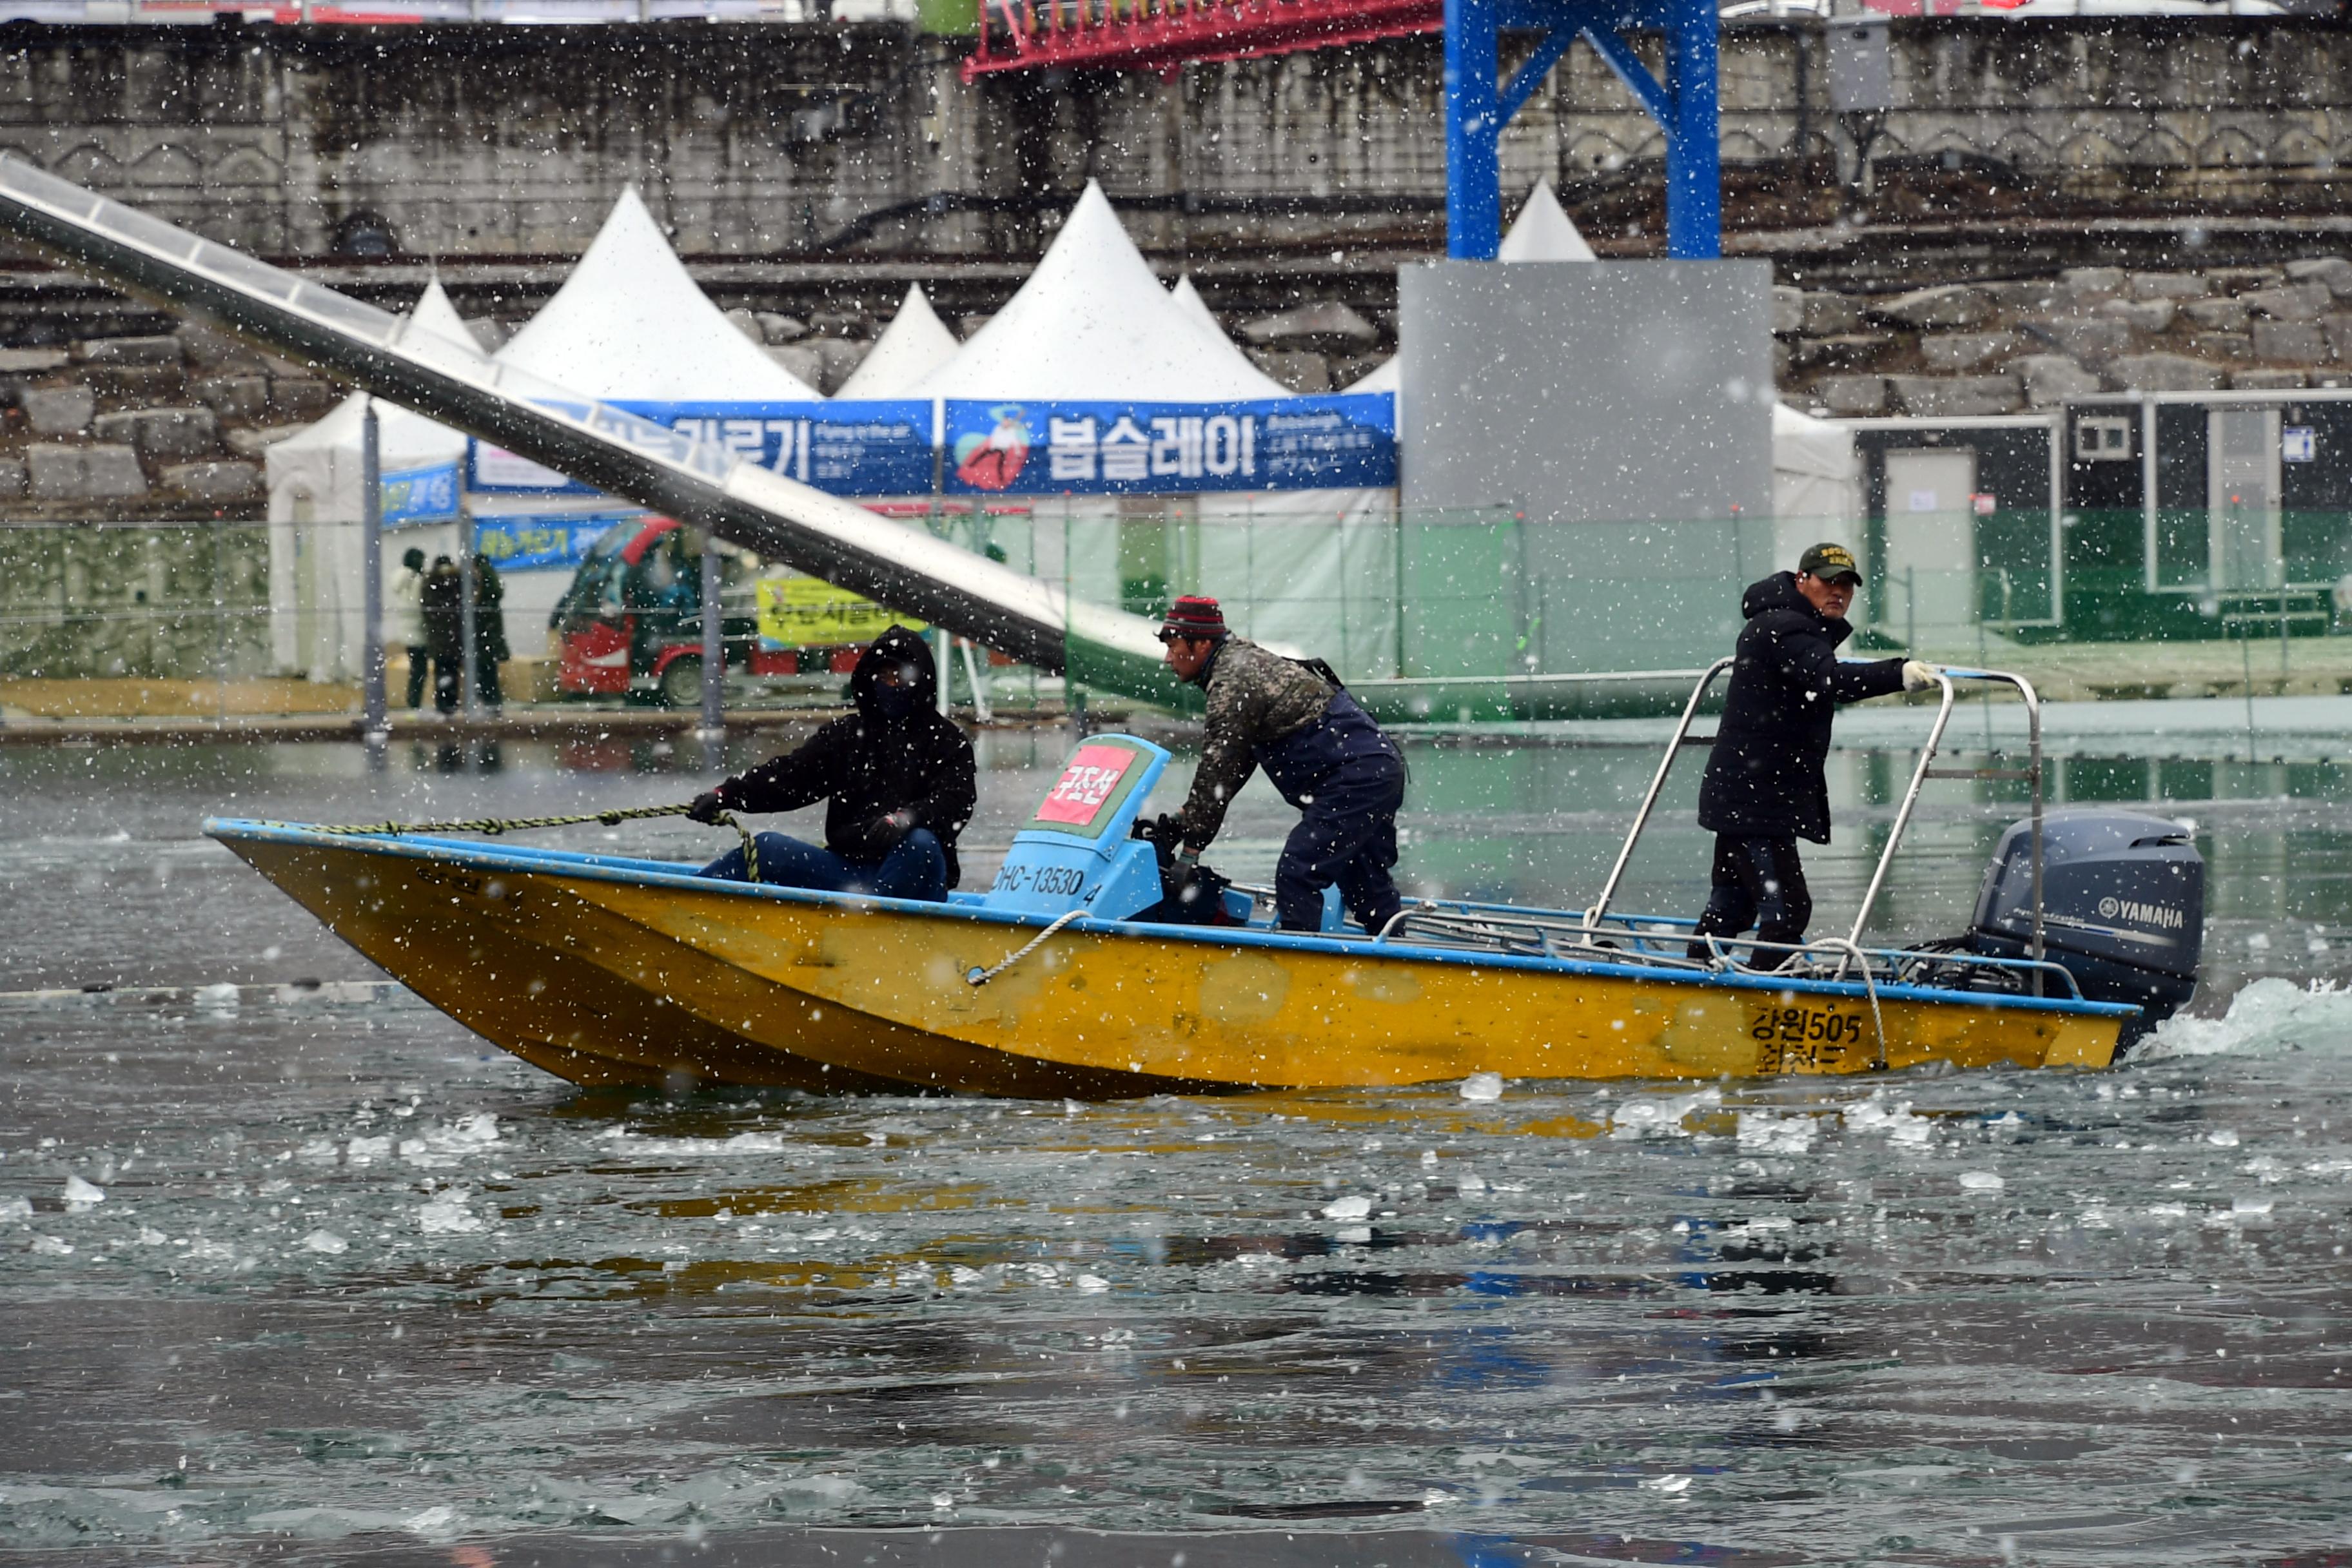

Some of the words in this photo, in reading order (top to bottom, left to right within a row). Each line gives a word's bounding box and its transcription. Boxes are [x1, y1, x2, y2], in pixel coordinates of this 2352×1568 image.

[1048, 416, 1255, 480] 봅슬레이
[1053, 765, 1119, 805] 구조선
[2119, 900, 2184, 929] YAMAHA
[1752, 1007, 1862, 1044] 강원505
